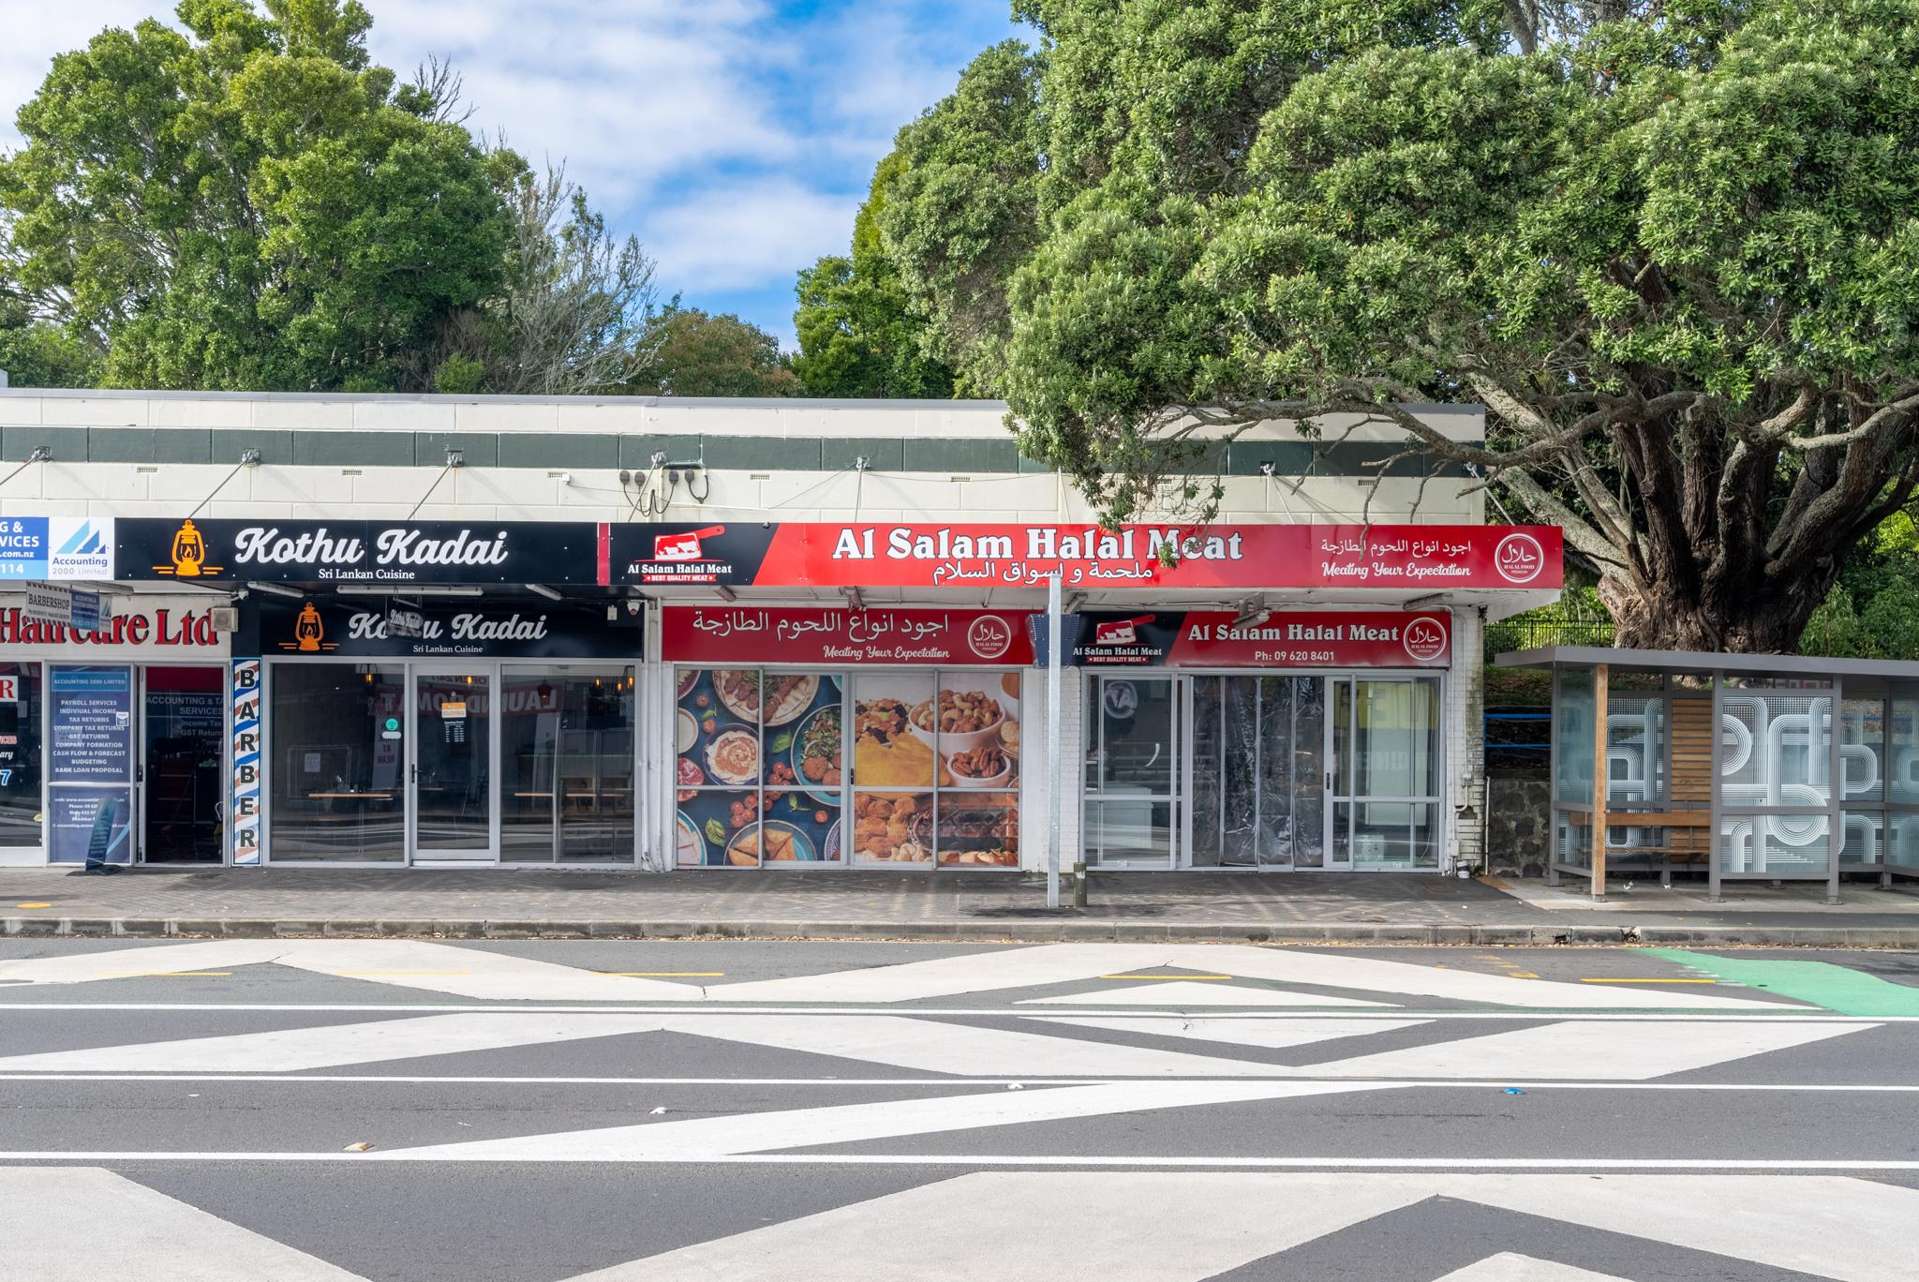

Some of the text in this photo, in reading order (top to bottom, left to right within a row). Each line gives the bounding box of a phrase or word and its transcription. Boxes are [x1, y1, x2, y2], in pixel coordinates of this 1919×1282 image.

[13, 521, 23, 533] &
[234, 527, 508, 565] Kothu Kadai
[832, 527, 1243, 560] Al Salam Halal Meat
[1370, 540, 1409, 558] اللحوم
[1412, 540, 1439, 558] انواع
[1443, 540, 1471, 556] اجود
[52, 557, 108, 567] Accounting
[627, 563, 732, 574] Al Salam Halal Meat
[1089, 561, 1153, 578] ملحمة
[1322, 562, 1472, 579] Meating Your Expectation
[318, 568, 415, 580] Sri Lankan Cuisine
[933, 561, 995, 585] السلام
[28, 593, 70, 611] BARBERSHOP
[154, 608, 219, 646] Ltd
[451, 614, 547, 640] Kadai
[692, 610, 769, 637] الطازجة
[776, 612, 841, 641] اللحوم
[900, 614, 948, 640] اجود
[1188, 624, 1399, 641] Al Salam Halal Meat
[413, 645, 483, 653] Sri Lankan Cuisine
[822, 645, 951, 661] Meating Your Expectation
[1072, 647, 1162, 655] Al Salam Halal Meat
[1255, 651, 1335, 661] Ph: 09 620 8401
[240, 668, 256, 848] BARBER
